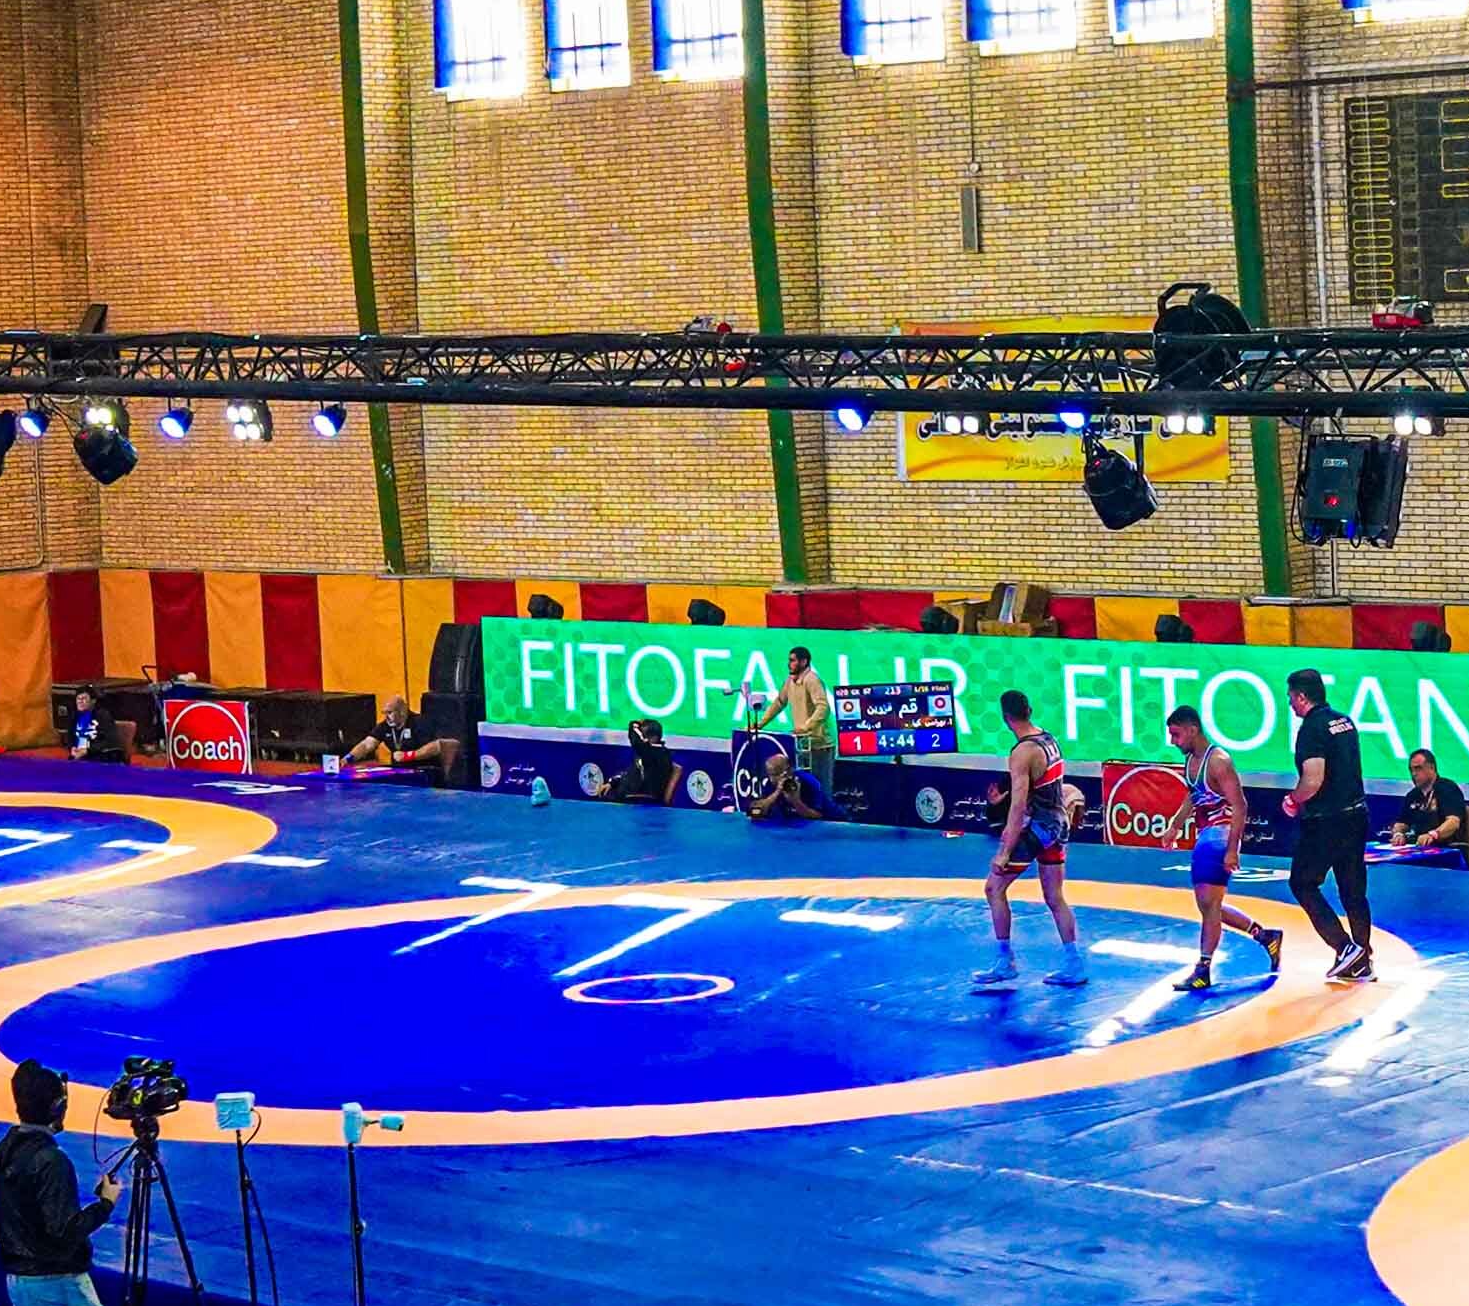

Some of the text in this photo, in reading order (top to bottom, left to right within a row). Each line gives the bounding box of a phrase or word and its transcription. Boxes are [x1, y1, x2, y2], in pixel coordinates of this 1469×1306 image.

[898, 698, 919, 719] قم
[173, 734, 242, 761] Coach
[853, 736, 862, 751] 1
[878, 733, 916, 748] 4:44
[931, 733, 941, 748] 2
